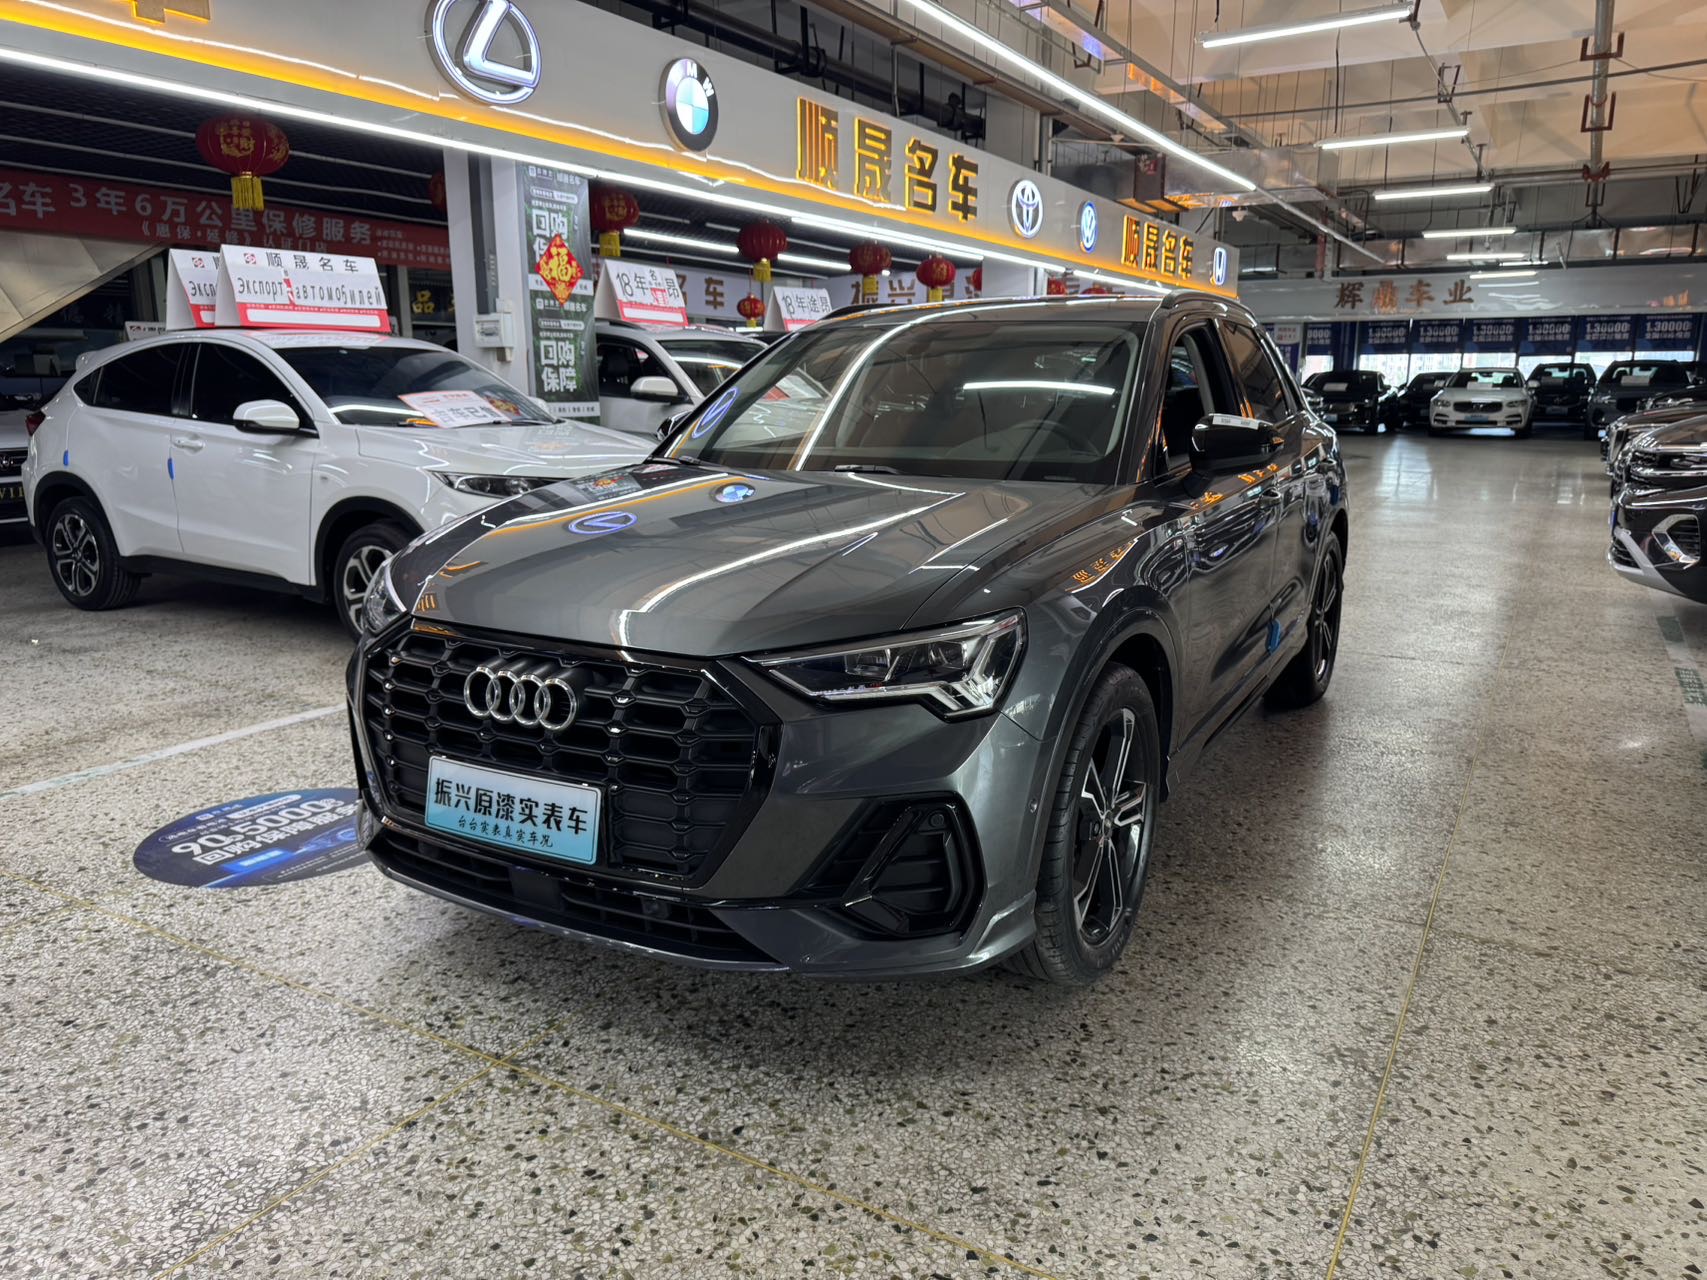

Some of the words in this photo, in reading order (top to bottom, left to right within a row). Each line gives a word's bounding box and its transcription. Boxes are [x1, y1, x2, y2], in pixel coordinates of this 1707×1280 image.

[796, 96, 978, 223] 顺晟名车
[1121, 214, 1194, 280] 顺晟名车
[265, 251, 359, 273] 顺晟名车
[237, 277, 283, 302] Экспорт
[295, 283, 382, 306] автомобилей
[540, 340, 574, 366] 回购
[541, 367, 577, 392] 保障
[434, 777, 589, 835] 振兴原漆实表车
[458, 815, 553, 848] 台台实表真实车况
